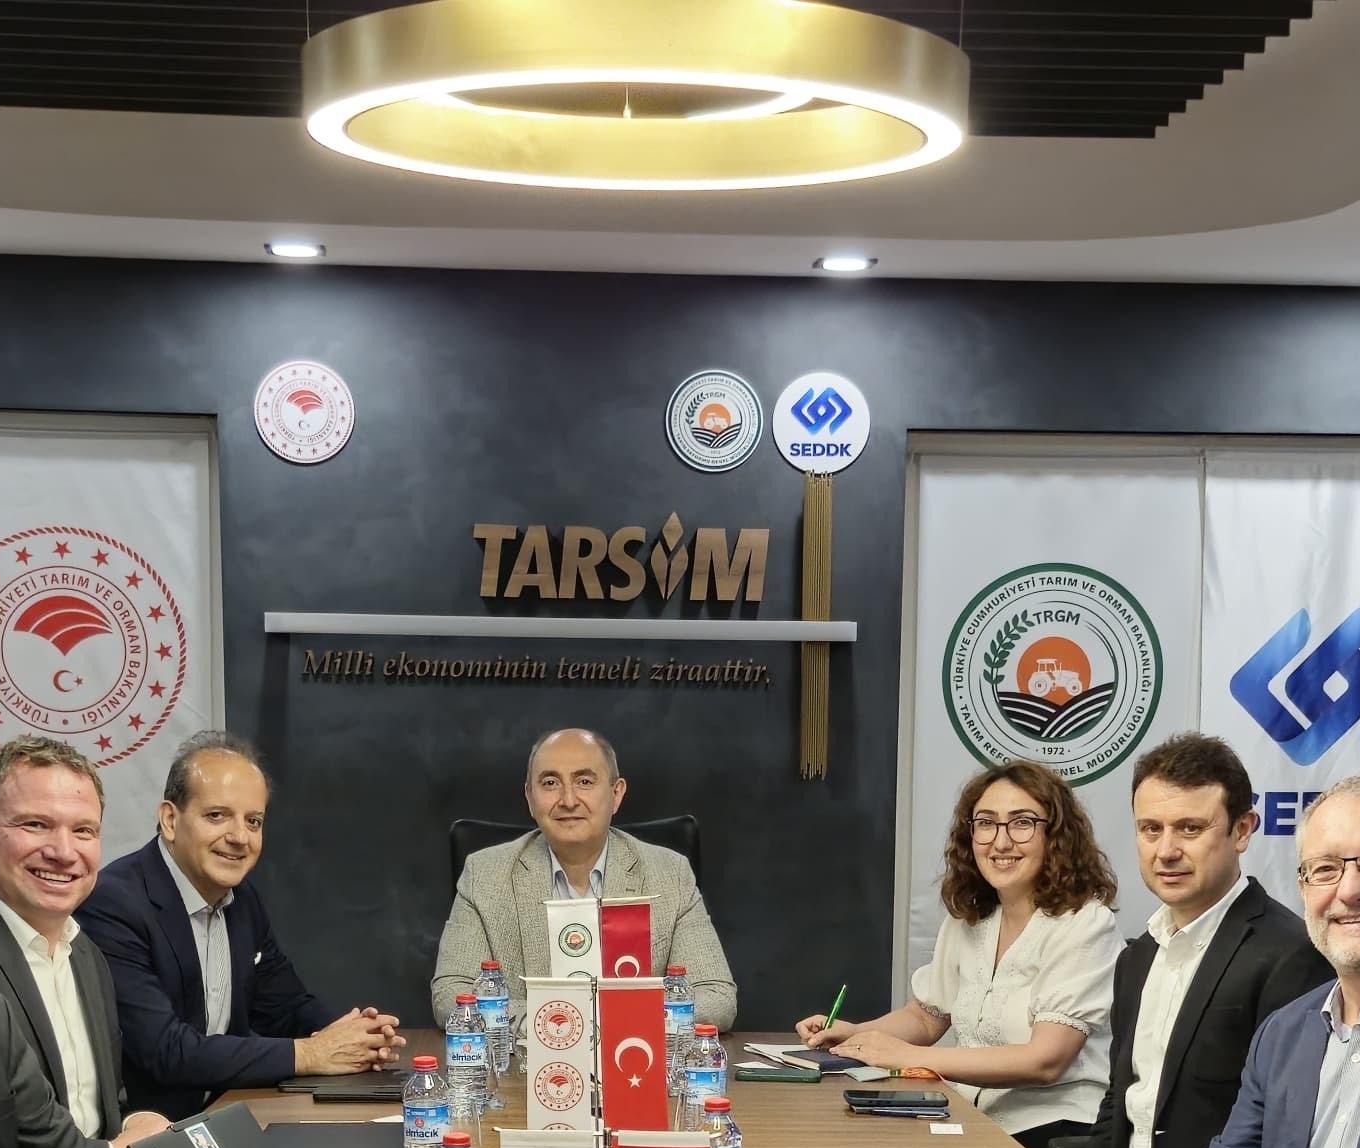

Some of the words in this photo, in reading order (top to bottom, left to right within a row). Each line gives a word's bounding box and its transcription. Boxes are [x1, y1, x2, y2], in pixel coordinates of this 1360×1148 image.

[790, 443, 852, 457] SEDDK
[40, 573, 90, 588] TARIM
[95, 582, 113, 601] VE
[112, 600, 141, 655] ORMAN
[1032, 609, 1081, 626] TRGM
[953, 637, 971, 692] TÜRKİYE
[968, 576, 1036, 636] CUMHURİYETİ
[1039, 576, 1078, 587] TARIM
[1081, 582, 1097, 593] VE
[1098, 589, 1134, 626] ORMAN
[1129, 624, 1153, 694] BAKANLIĞI
[302, 649, 374, 678] Milli
[382, 652, 547, 679] ekonominin
[556, 655, 640, 681] temeli
[82, 659, 140, 725] BAKANLIĞI
[959, 703, 984, 742] TARIM
[983, 741, 1012, 766] REFO
[1086, 705, 1146, 770] MÜDÜRLÜĞÜ
[1042, 747, 1065, 756] 1972
